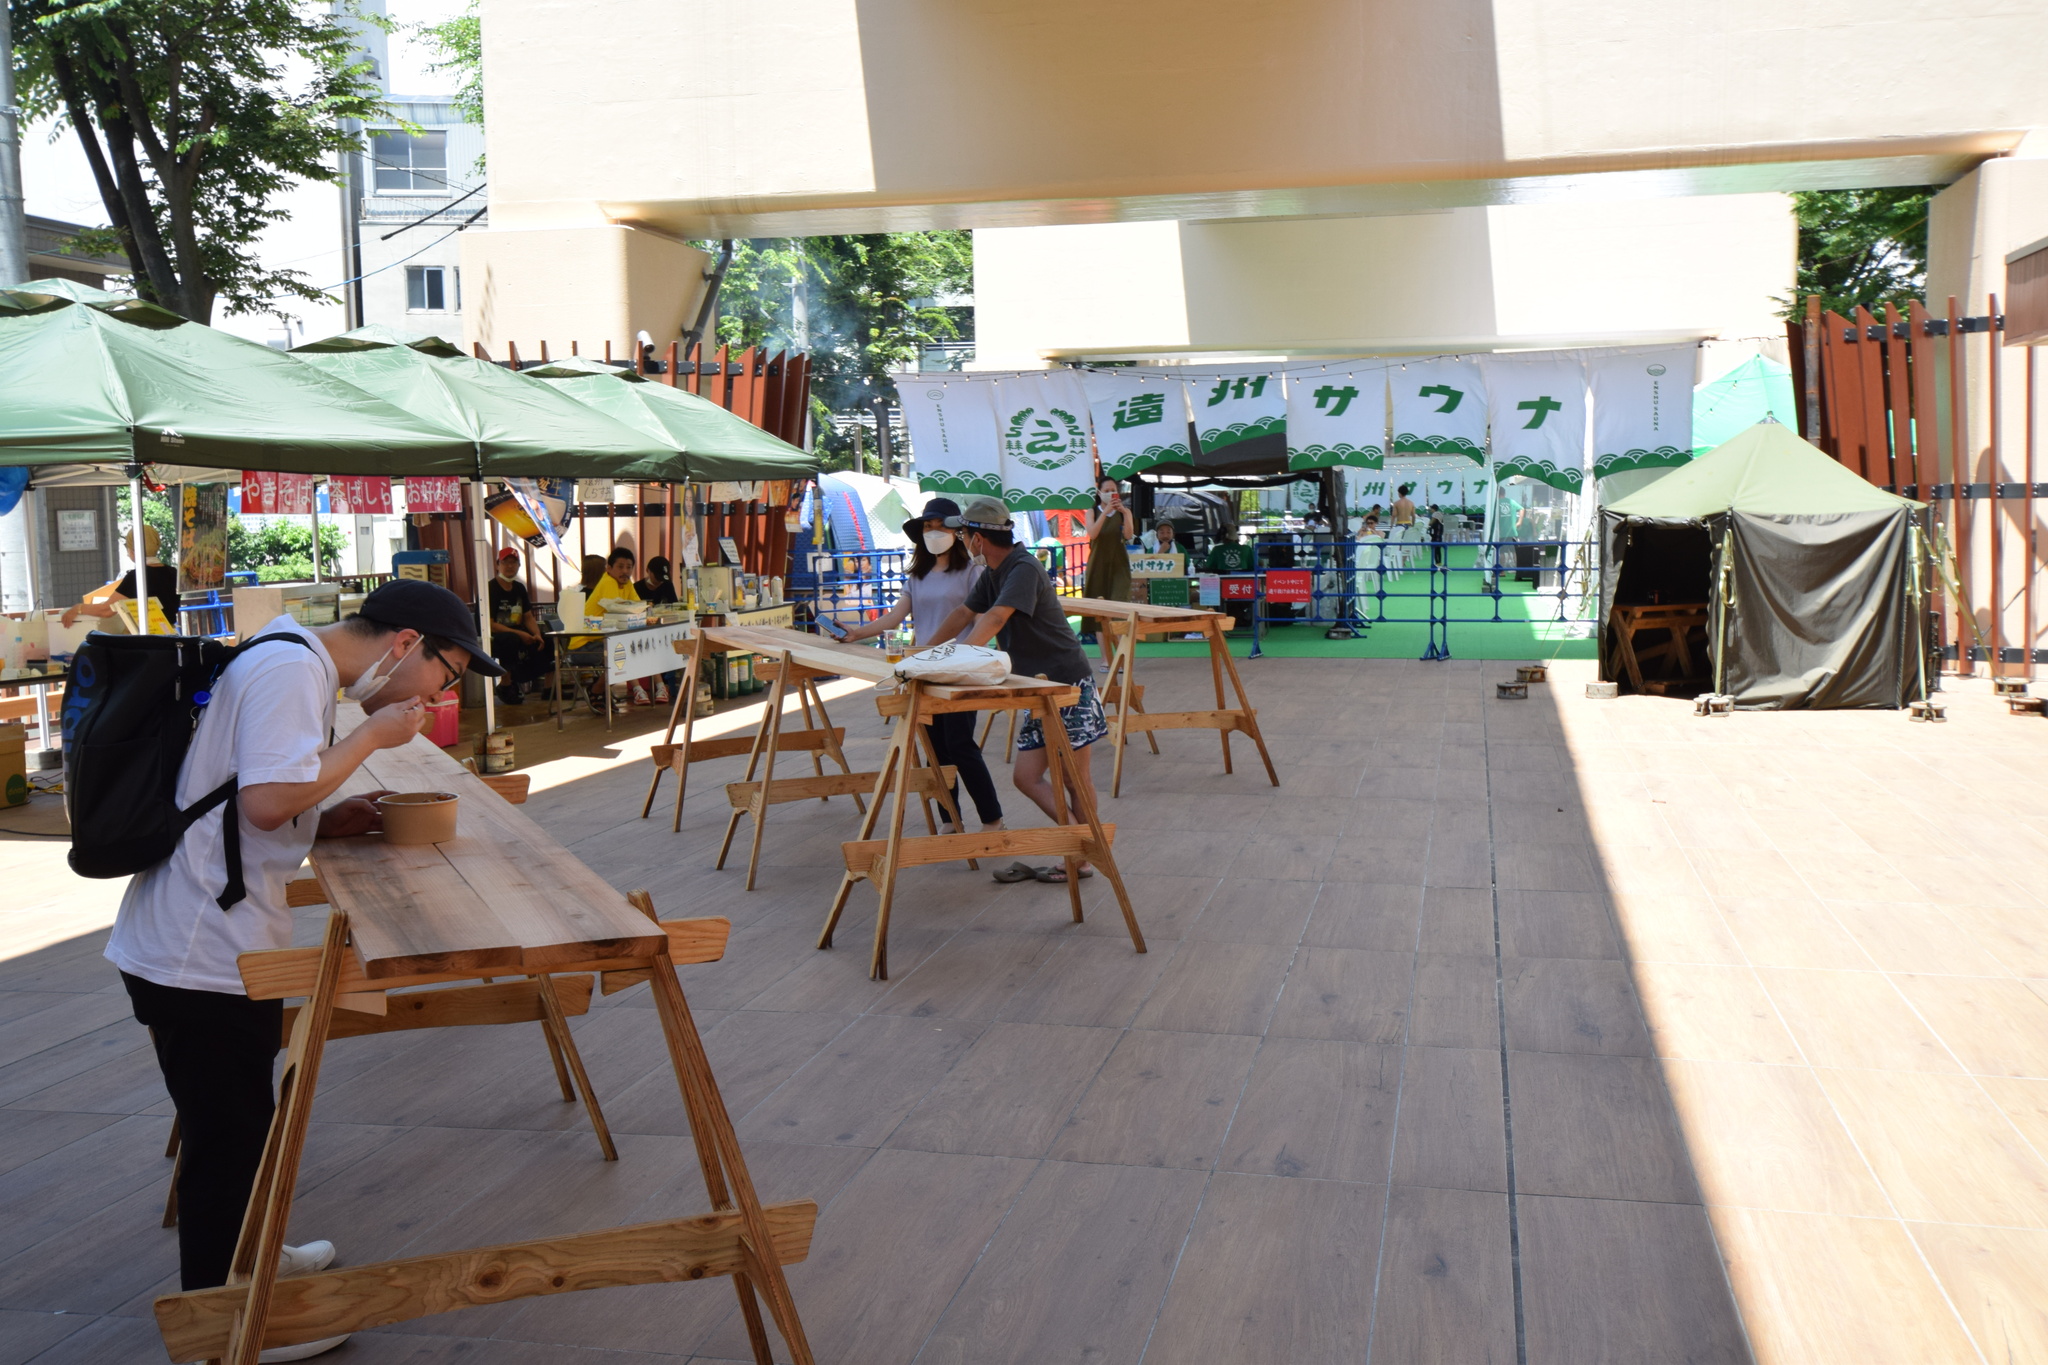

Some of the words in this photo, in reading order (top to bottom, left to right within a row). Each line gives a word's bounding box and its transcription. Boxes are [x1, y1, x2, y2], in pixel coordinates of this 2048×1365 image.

[936, 404, 945, 427] ENSHU
[941, 428, 949, 453] SAUNA
[242, 478, 312, 506] やきそば
[329, 479, 391, 506] 茶ばしら
[407, 479, 461, 504] お好み焼
[1130, 560, 1174, 572] 州サウナ
[1228, 584, 1253, 595] 受付
